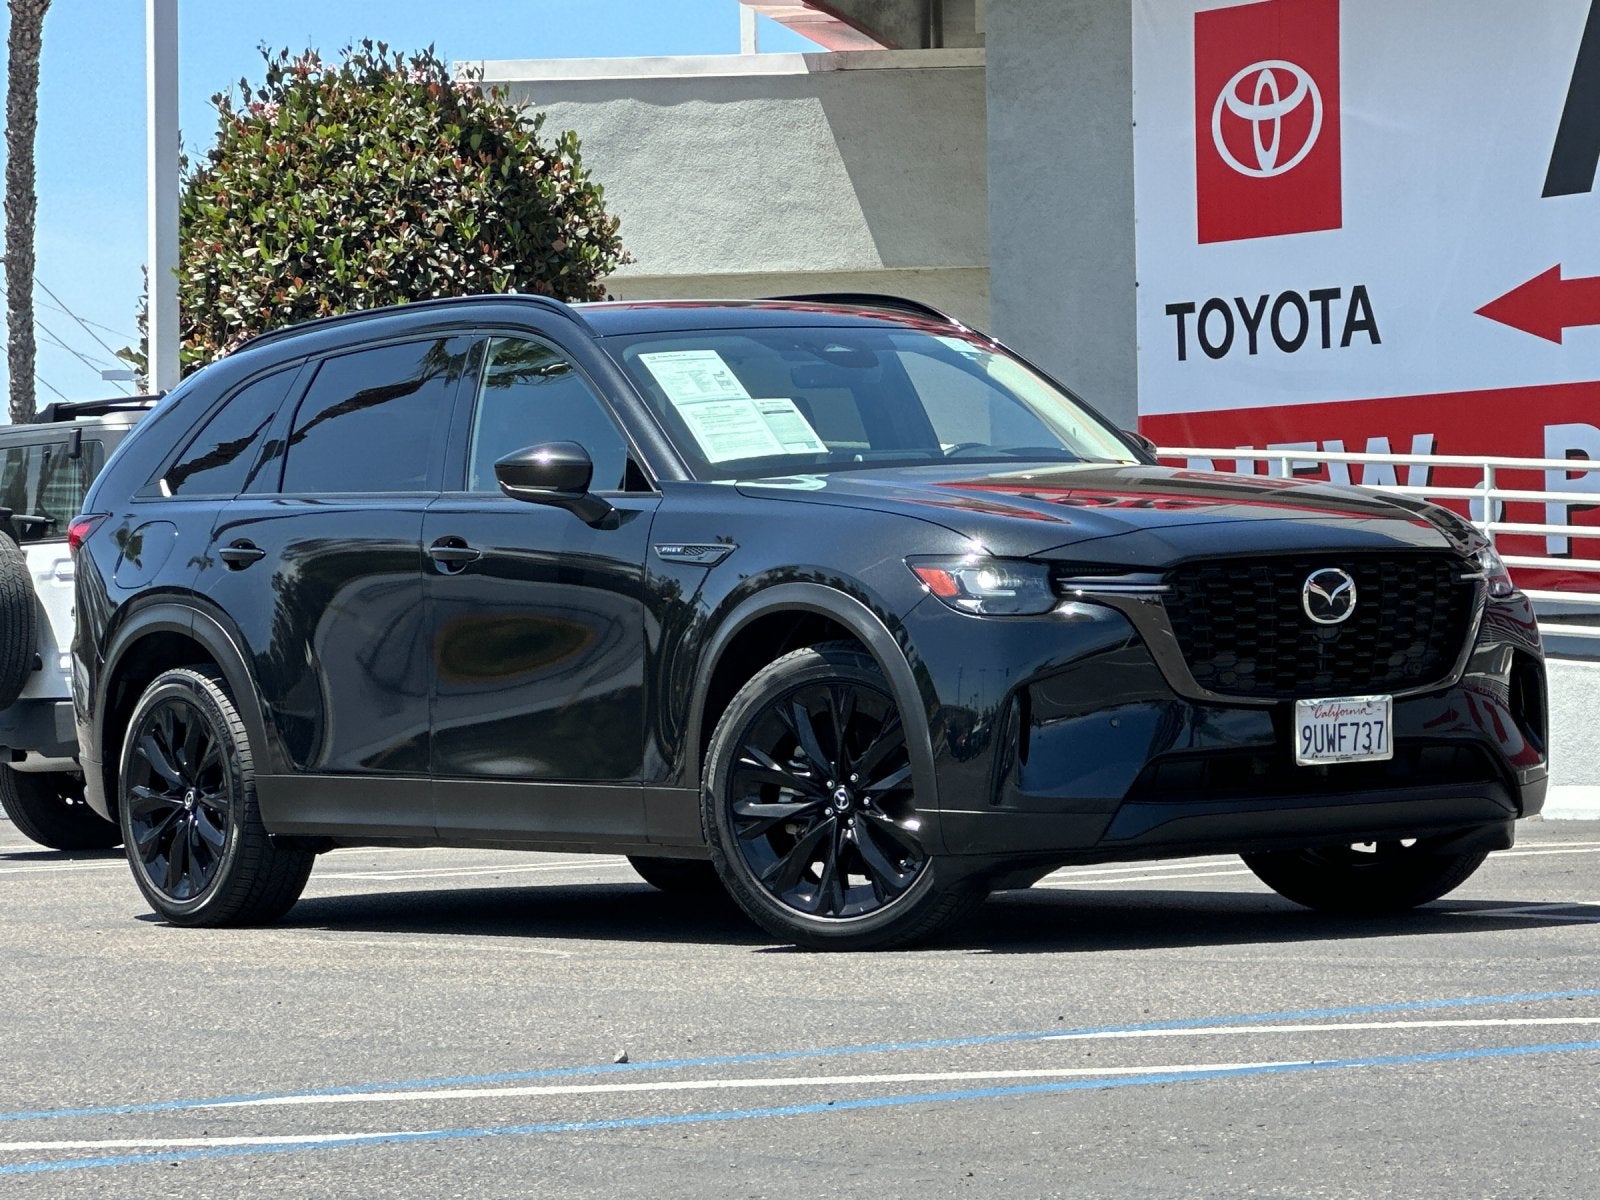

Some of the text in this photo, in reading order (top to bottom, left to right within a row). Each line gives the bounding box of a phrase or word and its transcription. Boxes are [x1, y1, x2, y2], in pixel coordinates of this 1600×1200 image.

[1165, 285, 1382, 361] TOYOTA
[1313, 703, 1373, 721] California
[1302, 720, 1384, 755] 9UWF737
